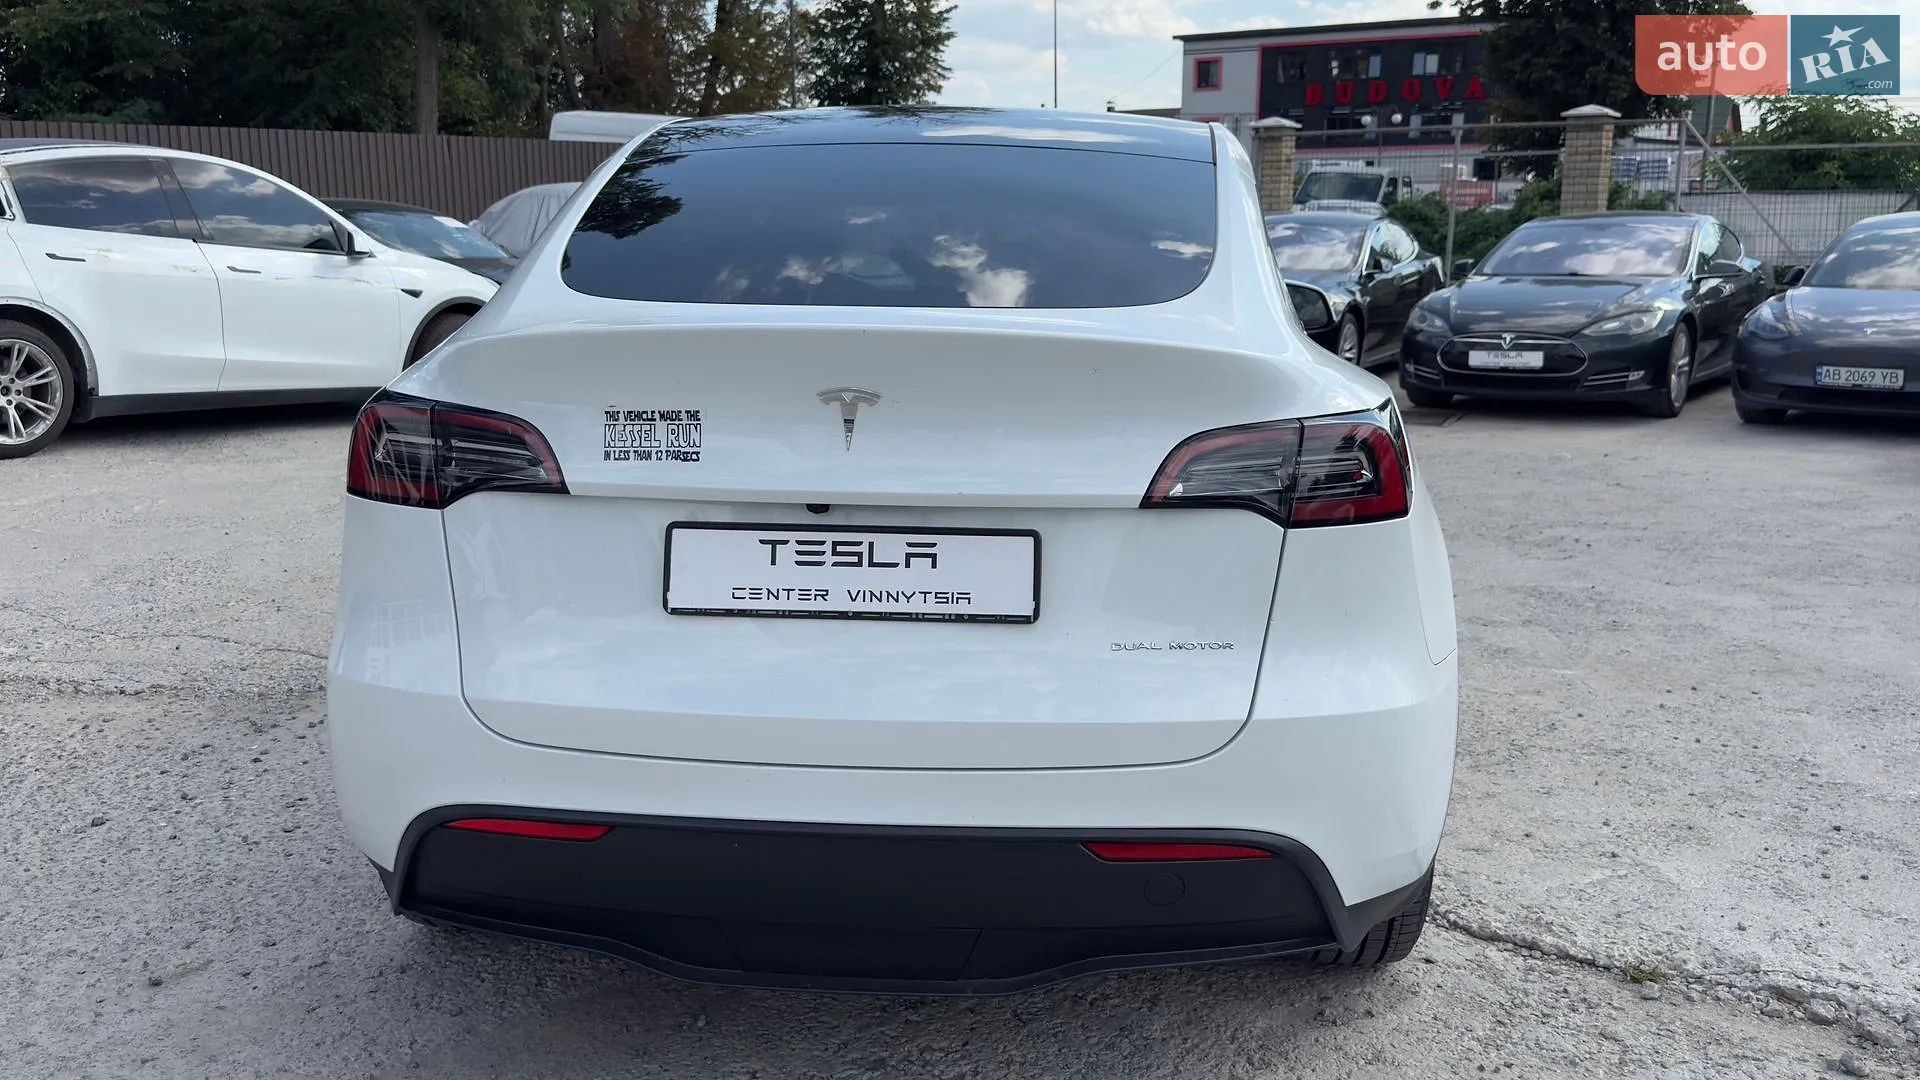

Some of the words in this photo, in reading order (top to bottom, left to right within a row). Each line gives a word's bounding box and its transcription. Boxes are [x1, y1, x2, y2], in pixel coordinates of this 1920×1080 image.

[1305, 75, 1486, 107] BUDOVA
[1822, 368, 1841, 381] AB
[1844, 369, 1876, 383] 2069
[1880, 371, 1899, 384] YB
[604, 410, 620, 422] THIS
[623, 410, 656, 422] VEHICLE
[658, 410, 683, 422] MADE
[685, 410, 701, 422] THE
[604, 423, 661, 448] KESSEL
[666, 423, 702, 448] RUN
[604, 450, 612, 461] IN
[613, 450, 631, 461] LESS
[633, 450, 652, 461] THAN
[655, 450, 663, 461] 12
[665, 450, 701, 462] PARSECS
[758, 538, 938, 570] TESLA
[731, 587, 829, 603] CENTER
[847, 589, 972, 605] VINNYTSIA
[1111, 641, 1163, 651] DUAL
[1168, 641, 1235, 650] MOTOR
